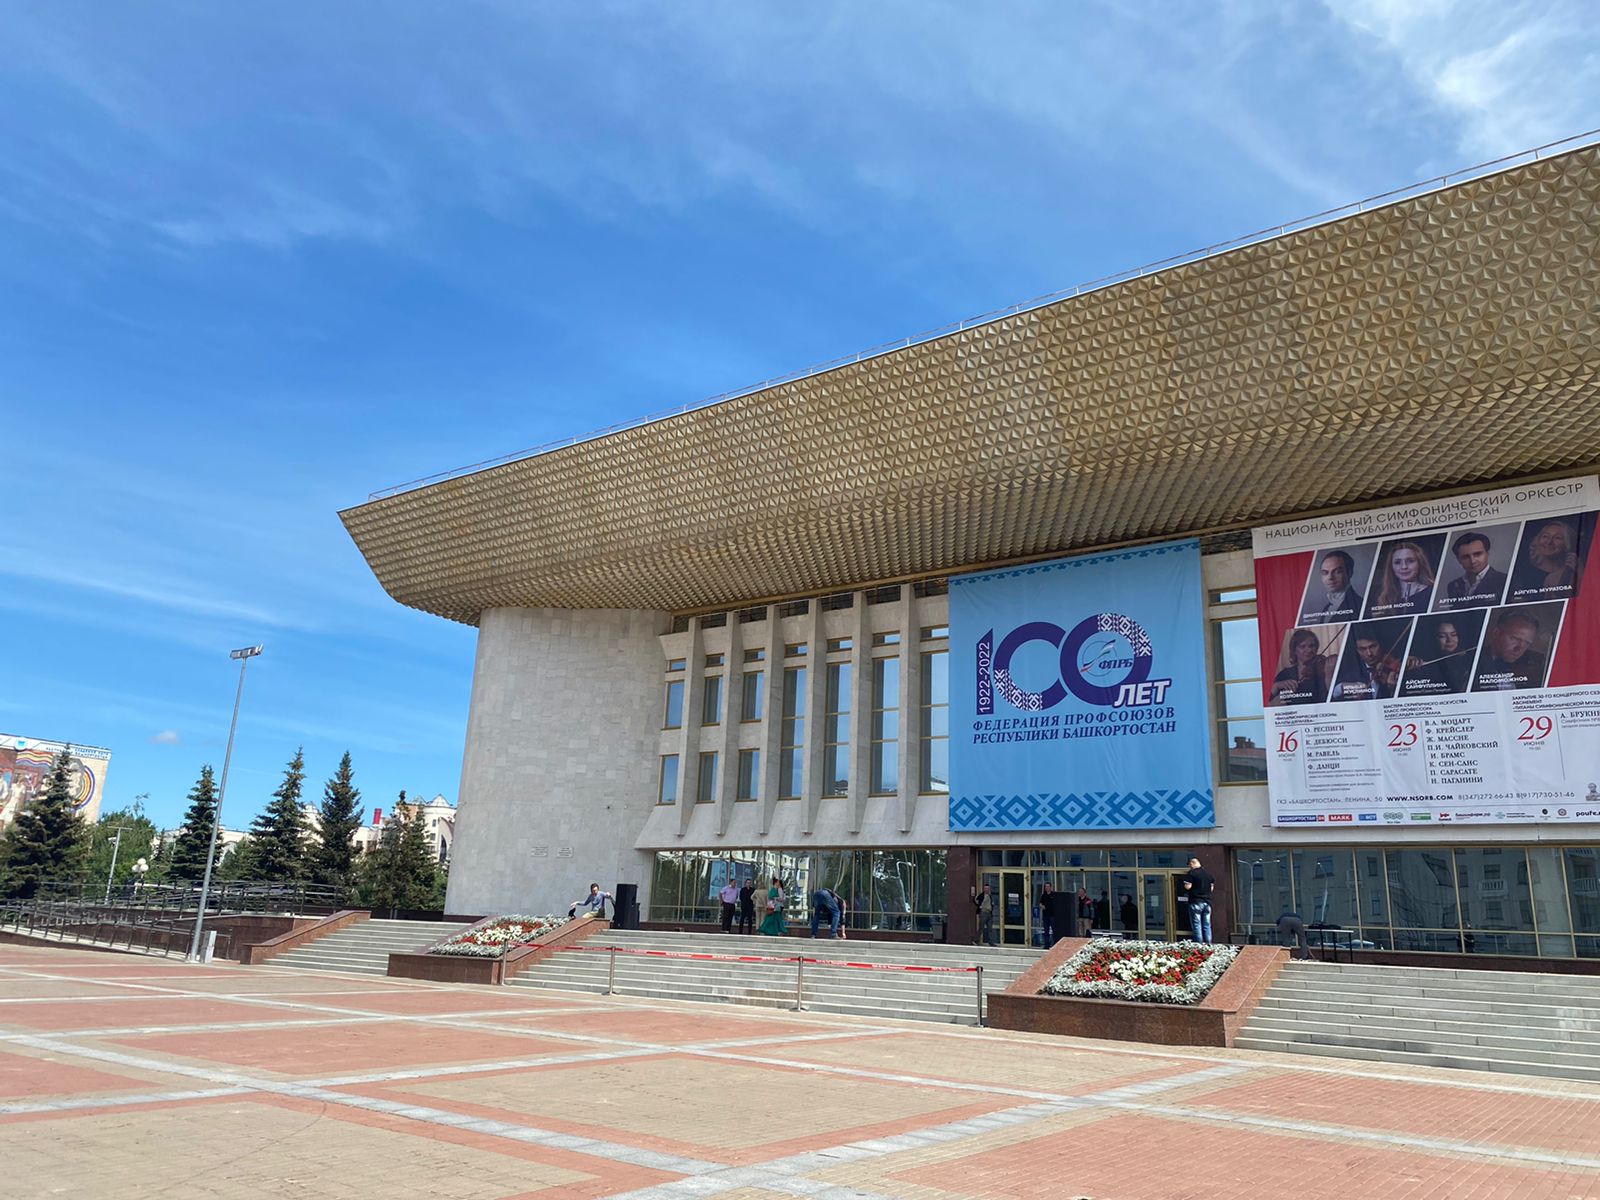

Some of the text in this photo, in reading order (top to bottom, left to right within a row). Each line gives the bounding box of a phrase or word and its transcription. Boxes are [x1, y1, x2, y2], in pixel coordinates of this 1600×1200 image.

[1265, 482, 1584, 539] НАЦИОНАЛЬНЫЙ СИМФОНИЧЕСКИЙ ОРКЕСТР
[1334, 507, 1500, 537] РЕСПУБЛИКИ БАШКОРТОСТАН
[1513, 585, 1573, 596] АЙГУЛЬ МУРАТОВА
[1330, 608, 1354, 616] КРЮКОВ
[1098, 658, 1134, 670] ФПРБ
[978, 641, 990, 713] 1922-2022
[1406, 682, 1447, 690] САЙФУЛЛИНА
[1113, 679, 1172, 708] ЛЕТ
[973, 707, 1175, 731] ФЕДЕРАЦИЯ ПРОФСОЮЗОВ
[1441, 718, 1471, 726] МОЦАРТ
[1313, 725, 1345, 733] РЕСПИГИ
[1436, 726, 1475, 734] КРЕЙСЛЕР
[1517, 715, 1553, 740] 29
[972, 721, 1176, 744] РЕСПУБЛИКИ БАШКОРТОСТАН
[1387, 723, 1418, 747] 23
[1276, 730, 1299, 752] 16
[1313, 737, 1348, 745] ДЕБЮССИ
[1445, 740, 1499, 750] ЧАЙКОВСКИЙ
[1315, 750, 1340, 758] РАВЕЛЬ
[1441, 751, 1465, 759] БРАМС
[1438, 759, 1479, 767] СЕН-САНС
[1440, 768, 1478, 776] САРАСАТЕ
[1441, 776, 1483, 785] ПАГАНИНИ
[1387, 794, 1454, 802] WWW.NSORB.COM
